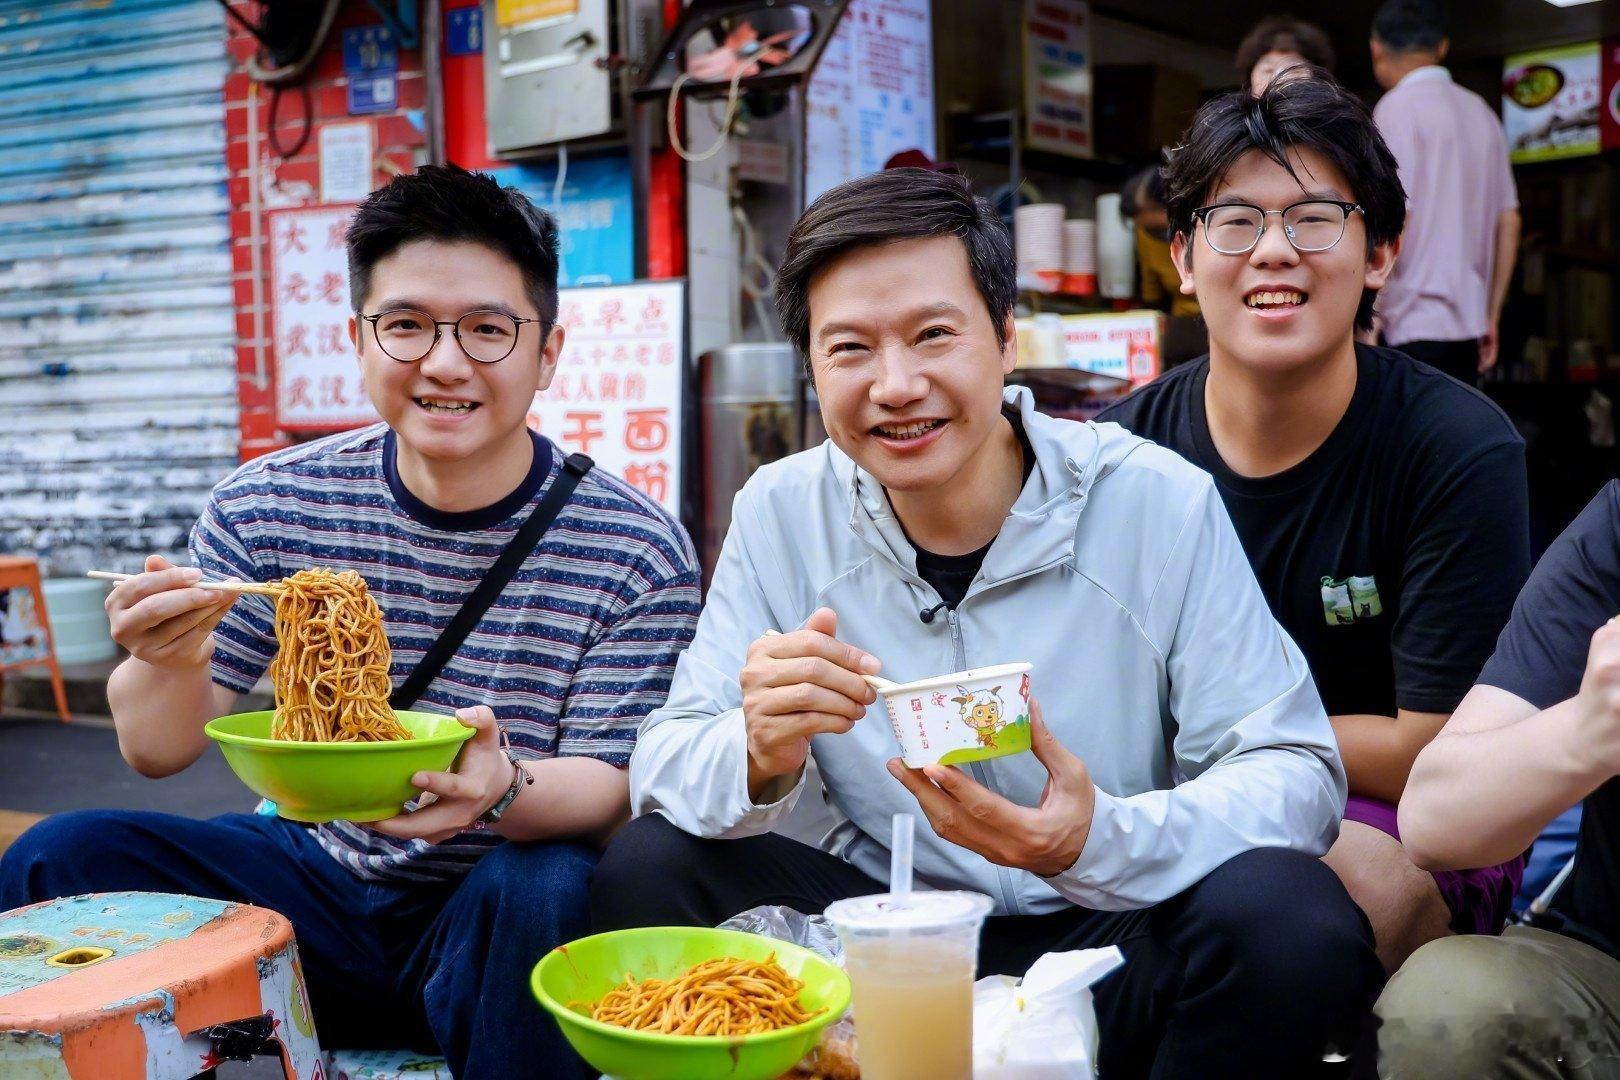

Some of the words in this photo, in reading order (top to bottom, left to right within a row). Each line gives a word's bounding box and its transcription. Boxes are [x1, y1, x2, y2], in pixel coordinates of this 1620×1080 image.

[286, 323, 346, 358] 武汉
[288, 374, 370, 411] 武汉
[537, 372, 646, 401] 汉人做的
[526, 407, 669, 454] 干面
